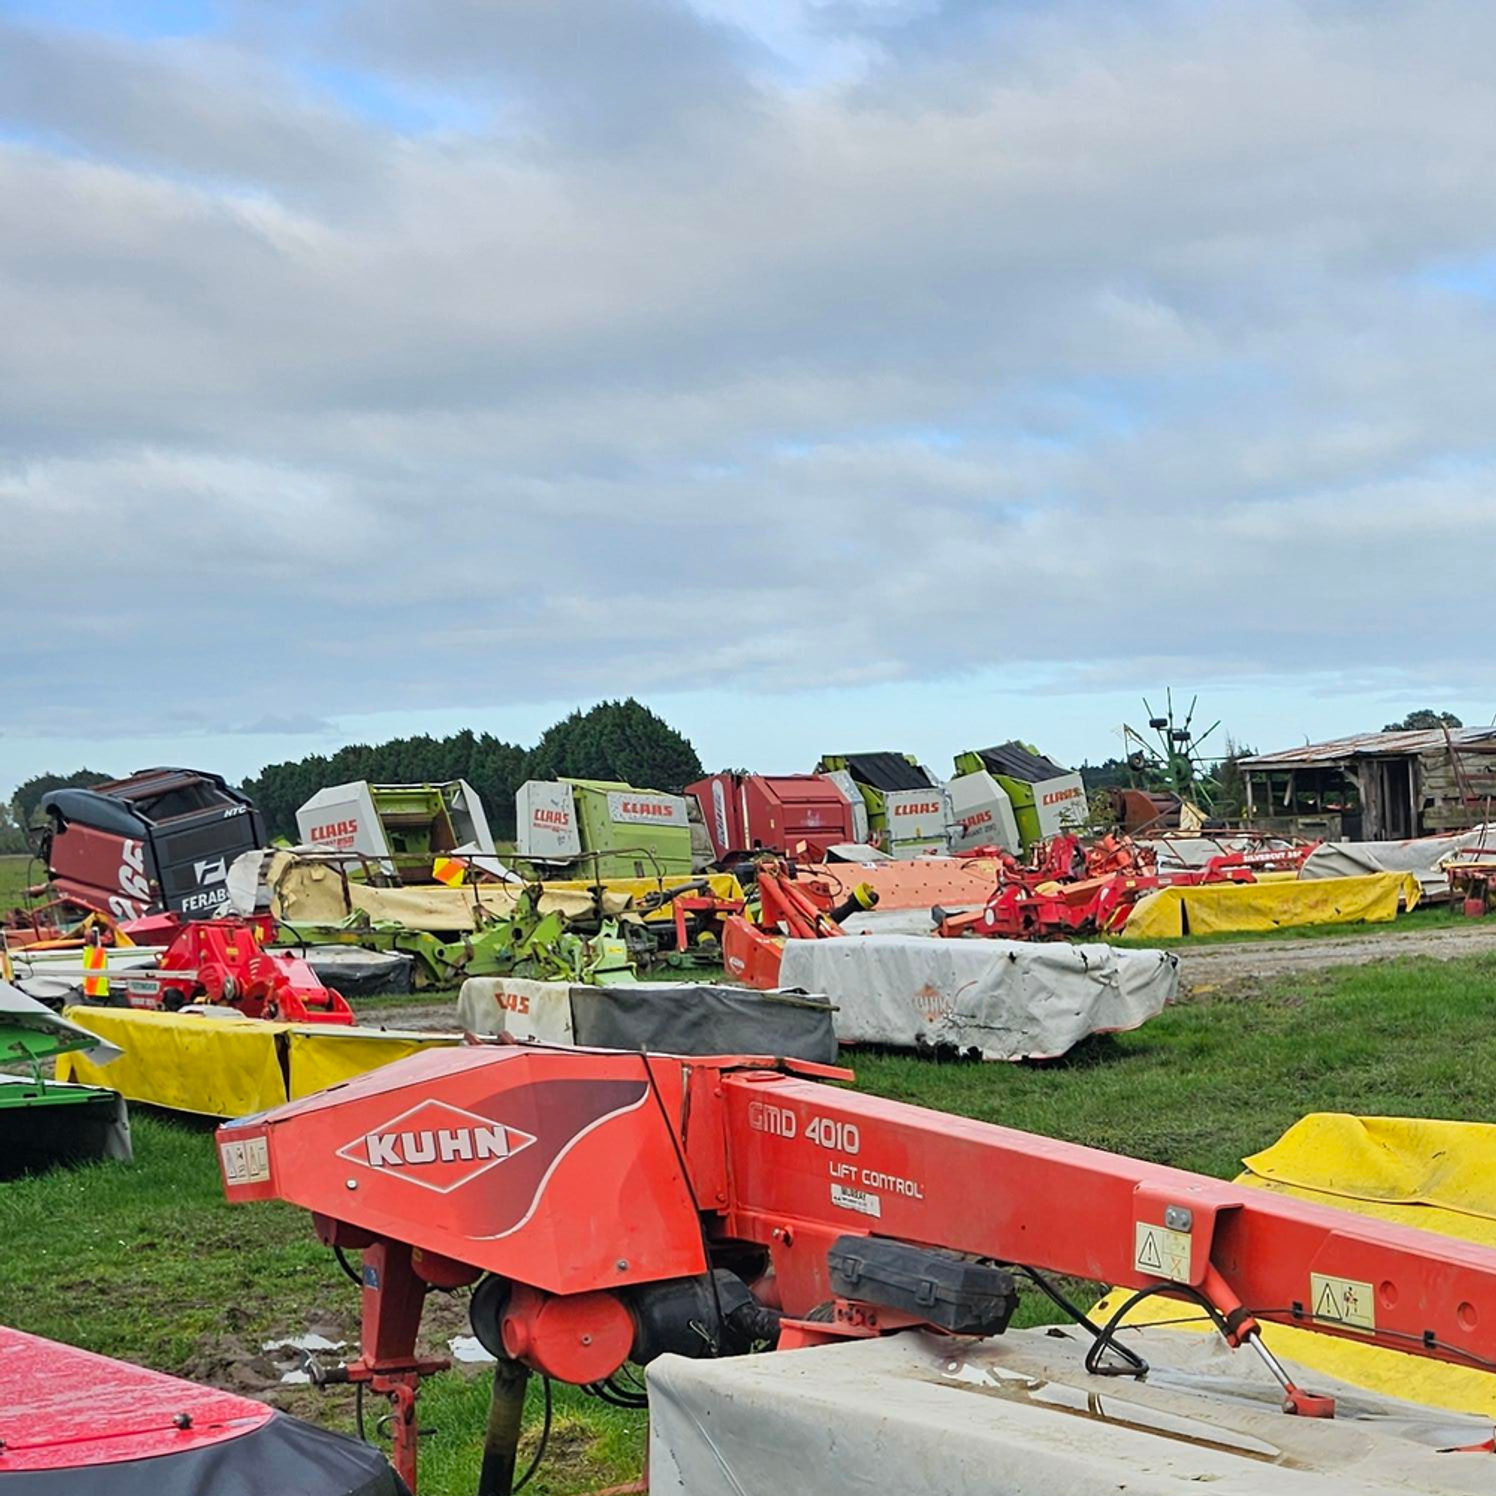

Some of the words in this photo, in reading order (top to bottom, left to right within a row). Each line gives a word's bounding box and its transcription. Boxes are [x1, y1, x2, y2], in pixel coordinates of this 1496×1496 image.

[1043, 787, 1082, 806] CLAAS
[533, 809, 570, 826] CLAAS
[622, 802, 673, 817] CLAAS
[894, 801, 940, 816] CLAAS
[310, 819, 358, 841] CLAAS
[182, 888, 231, 912] FERAB
[749, 1102, 797, 1139] GMD
[804, 1116, 860, 1154] 4010
[365, 1125, 510, 1167] KUHN
[829, 1161, 858, 1182] LIFT
[861, 1169, 923, 1199] CONTROL
